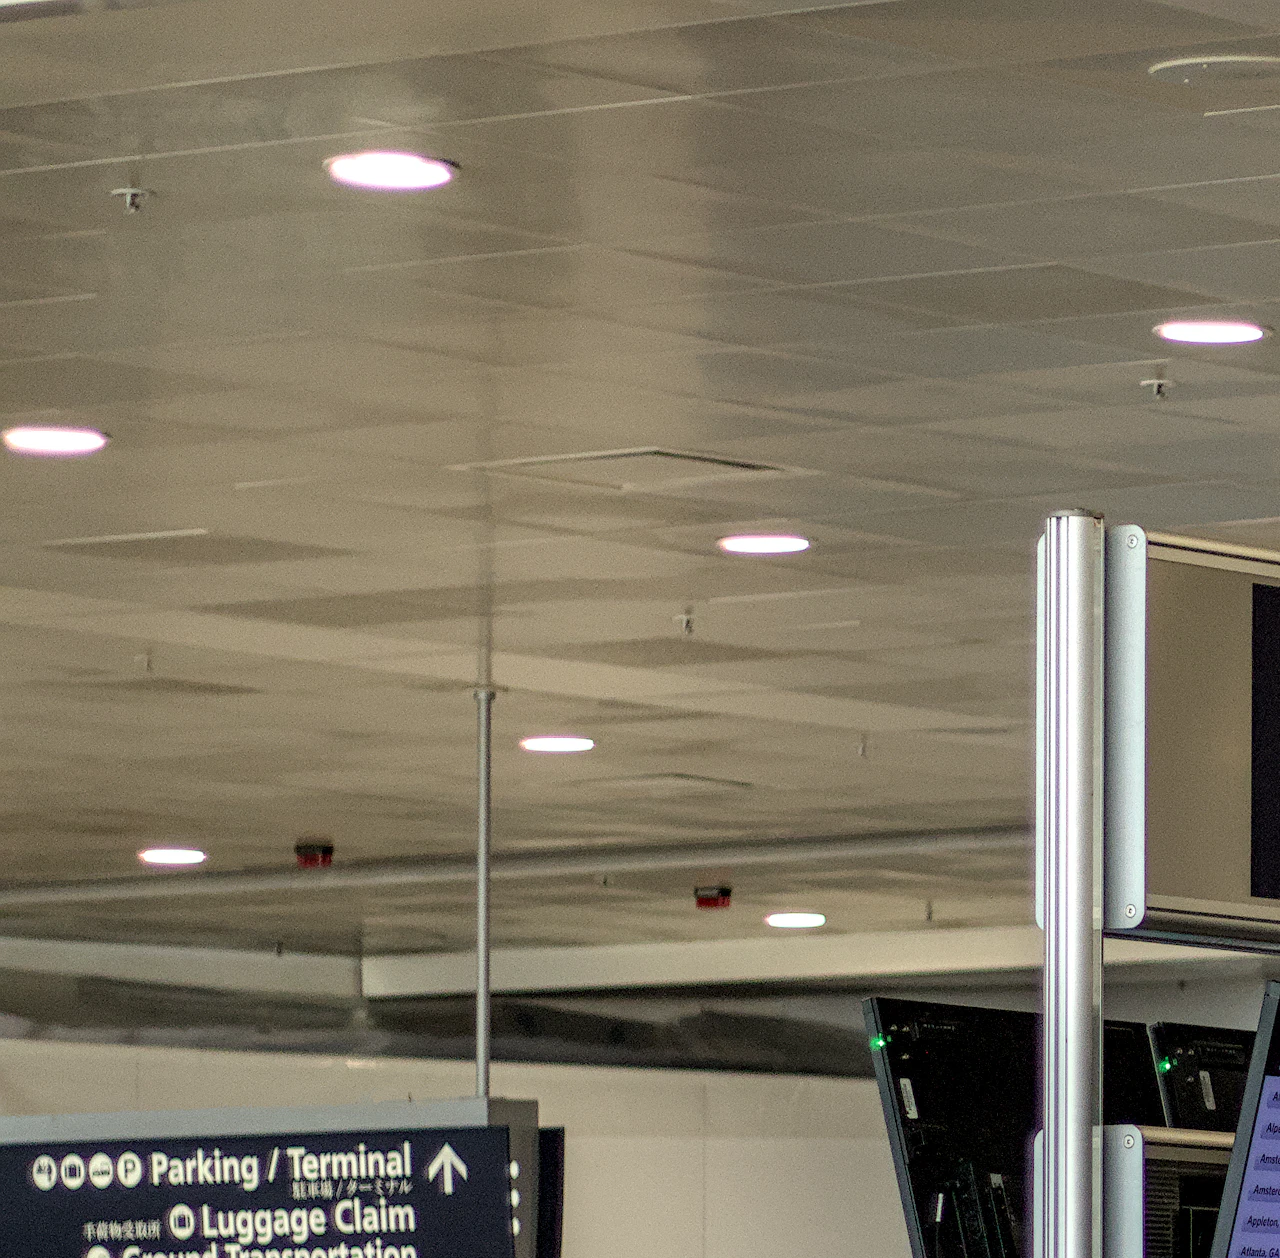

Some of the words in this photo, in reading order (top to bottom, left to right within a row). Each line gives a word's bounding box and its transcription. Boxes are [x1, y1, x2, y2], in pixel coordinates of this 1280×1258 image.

[151, 1149, 259, 1190] Parking
[268, 1148, 280, 1181] /
[287, 1141, 412, 1178] Terminal
[202, 1206, 326, 1244] Luggage
[335, 1198, 415, 1235] Claim
[1241, 1246, 1266, 1258] Atlanta,
[1269, 1248, 1279, 1258] GA
